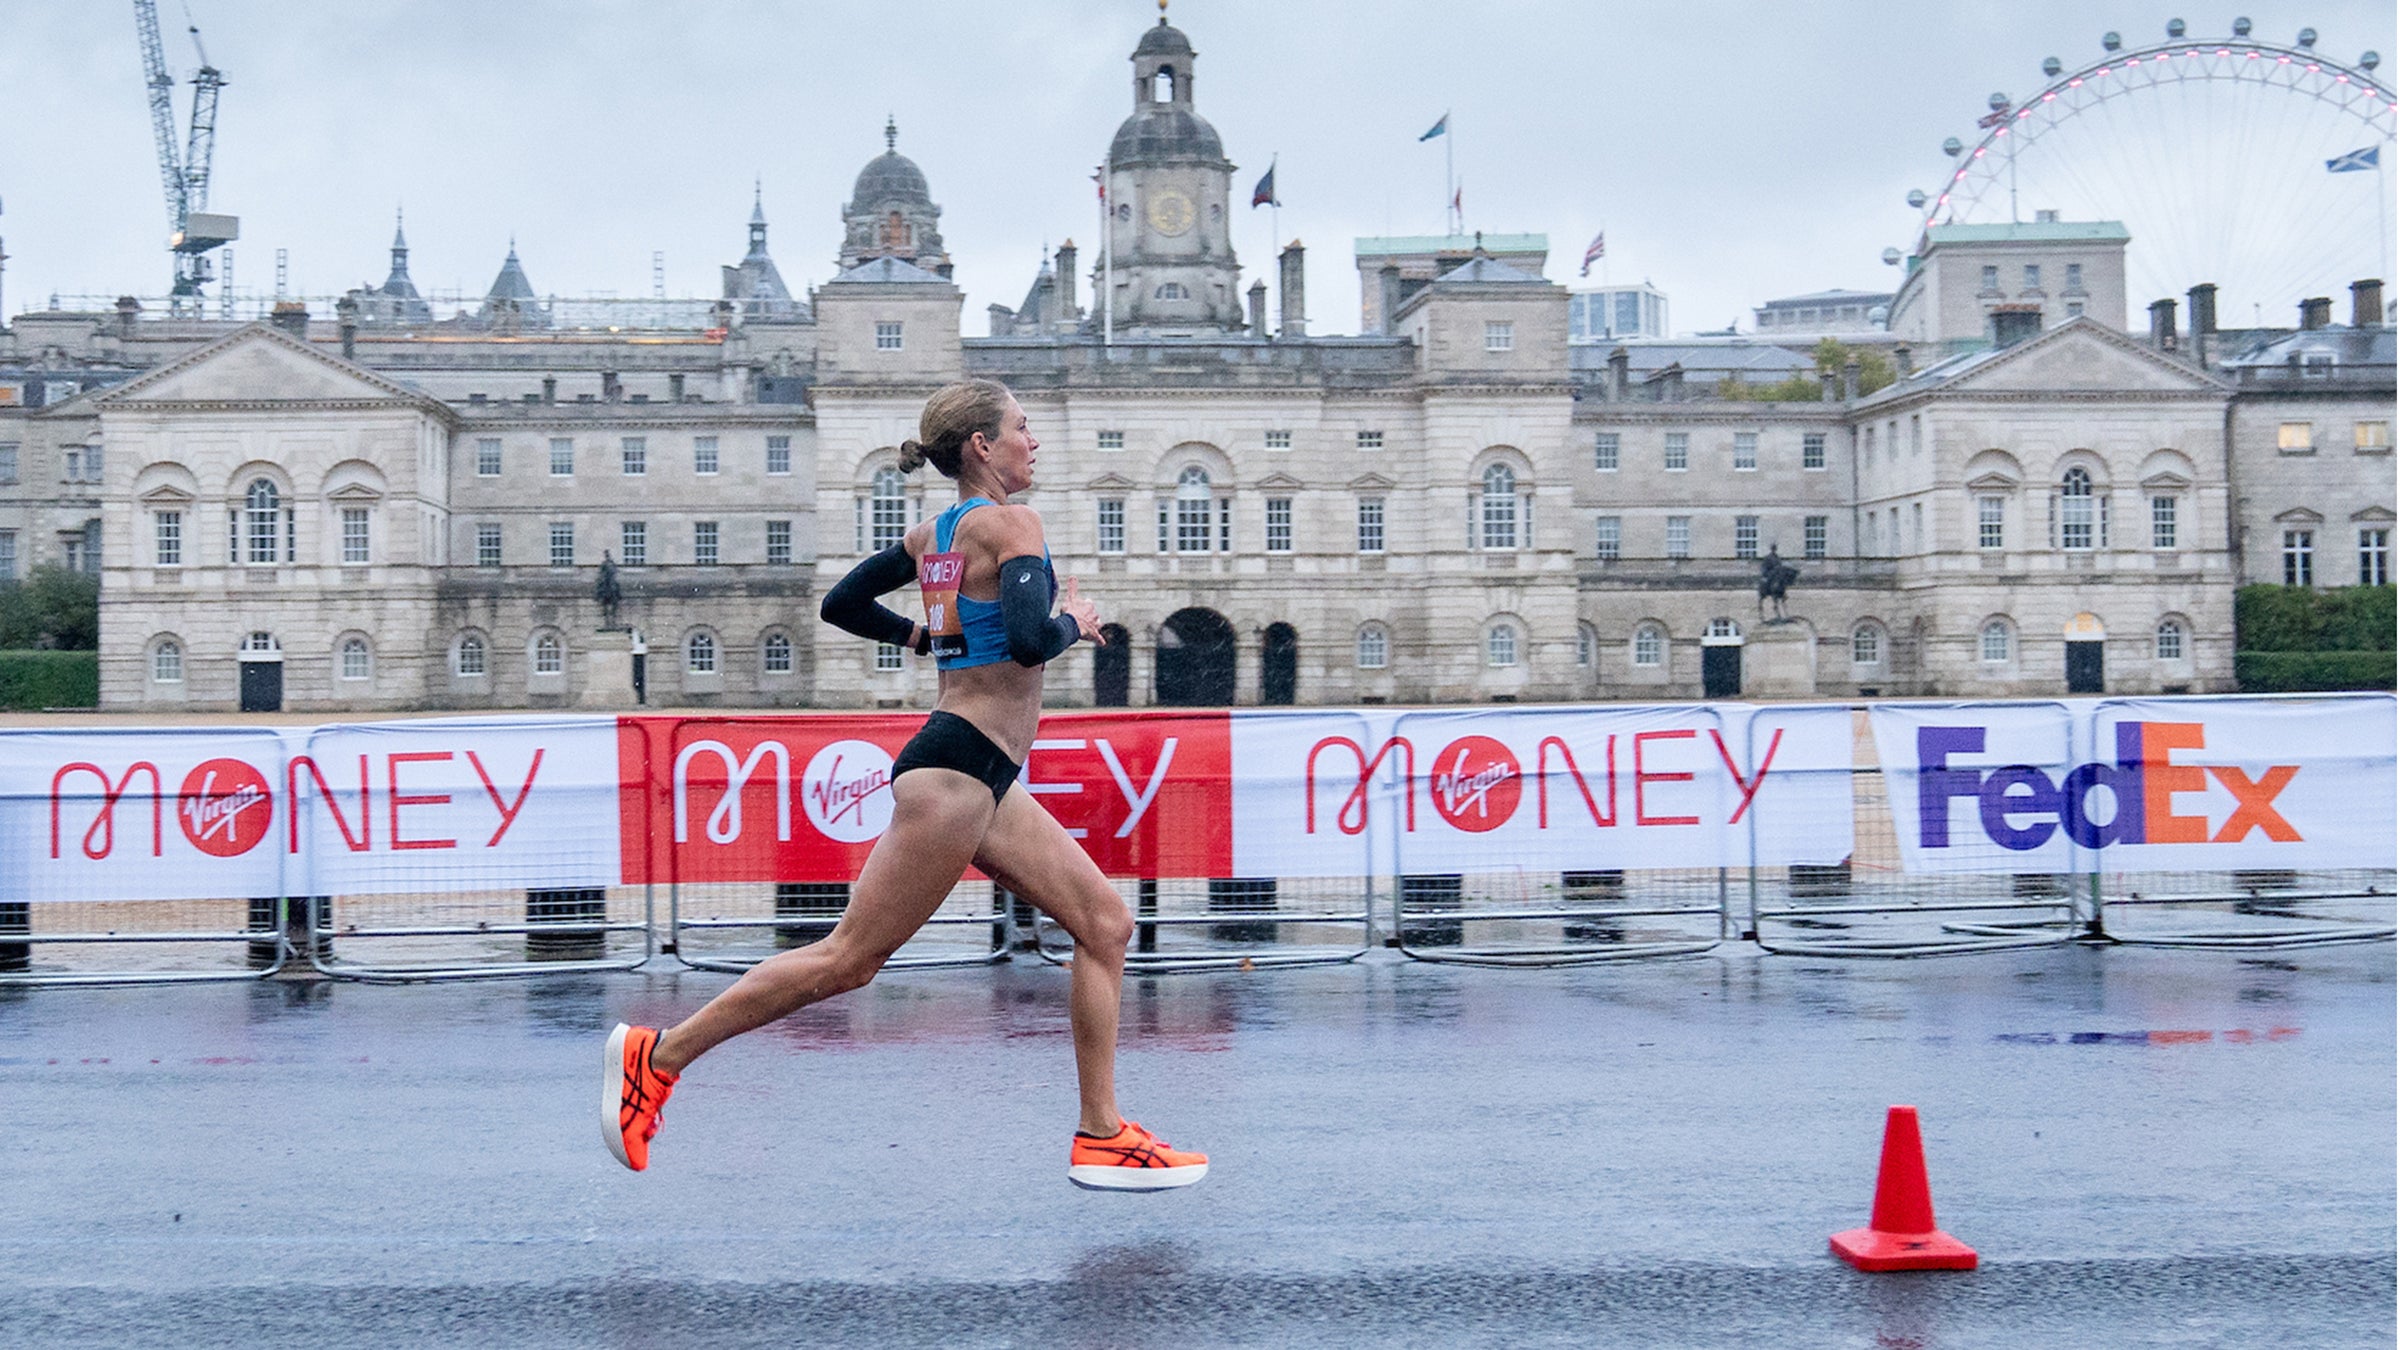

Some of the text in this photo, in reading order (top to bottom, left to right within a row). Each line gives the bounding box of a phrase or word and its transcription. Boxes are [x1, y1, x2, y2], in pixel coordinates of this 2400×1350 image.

[51, 748, 546, 860] MONEY
[183, 769, 267, 842] Virgin
[673, 738, 1179, 845] MOEY
[811, 754, 892, 827] Virgin
[1306, 727, 1784, 836] MONEY
[1436, 747, 1516, 818] Virgin
[1917, 721, 2305, 852] FedEx
